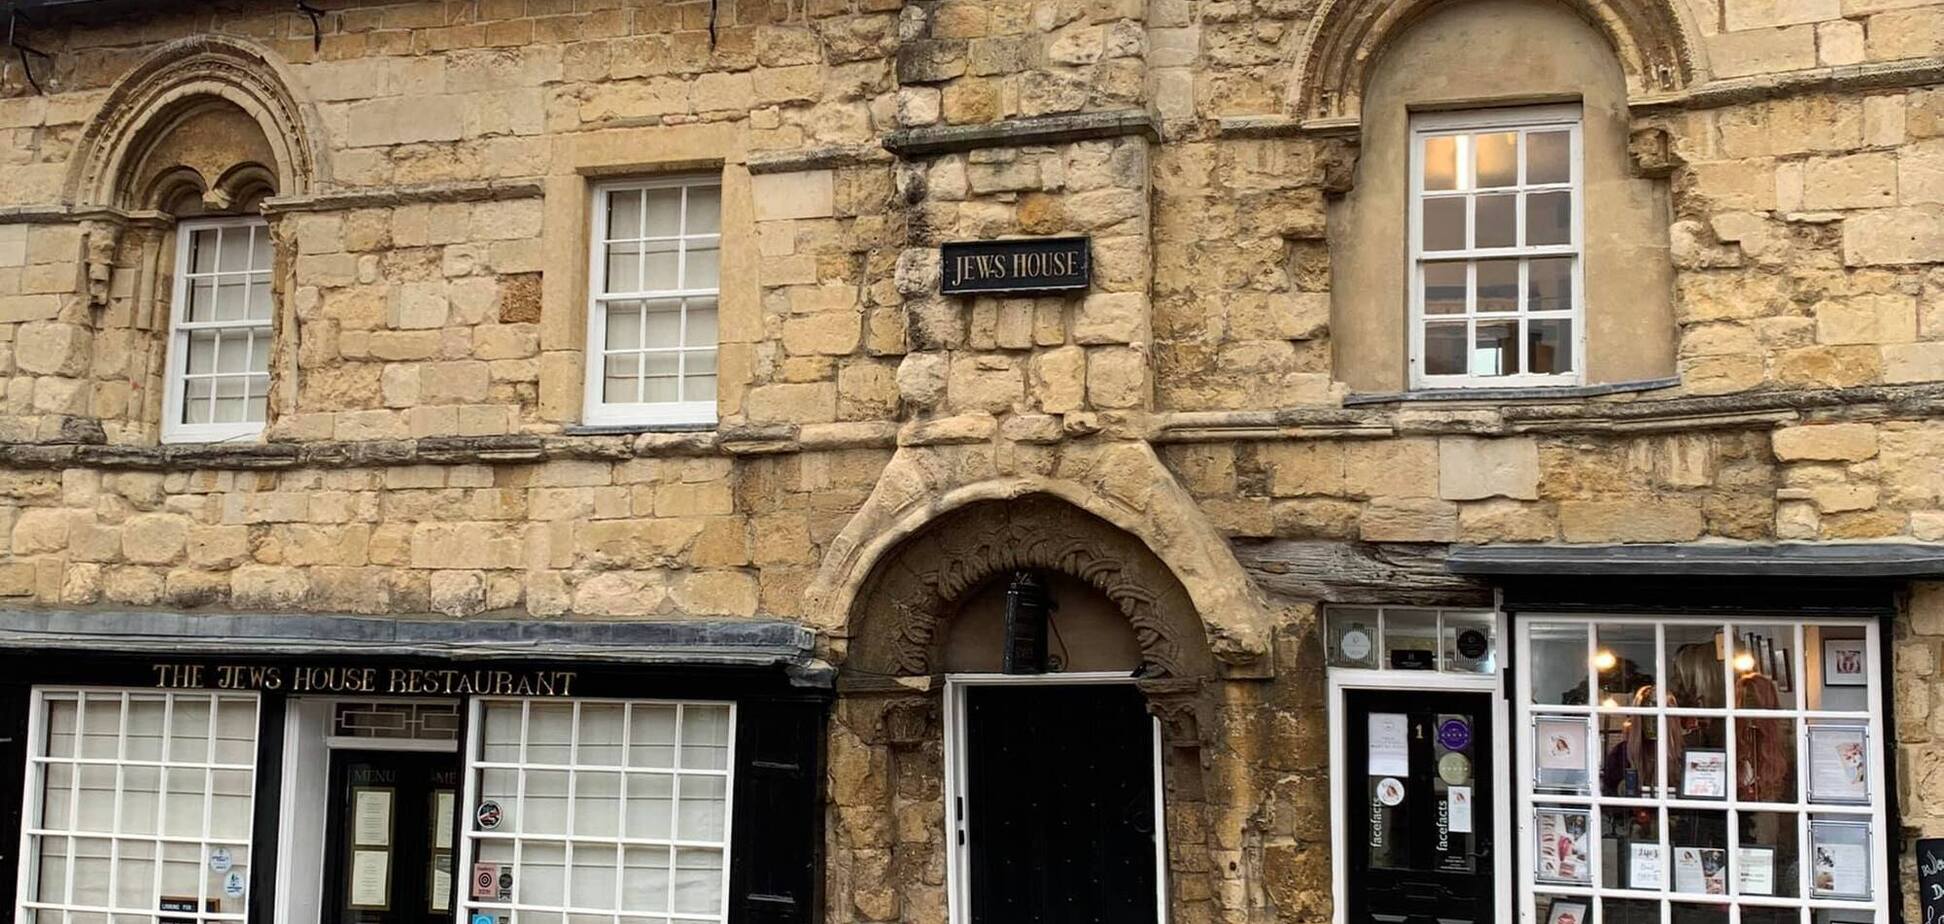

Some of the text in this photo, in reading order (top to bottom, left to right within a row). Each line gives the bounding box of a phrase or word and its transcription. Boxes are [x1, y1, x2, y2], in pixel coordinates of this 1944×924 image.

[1012, 251, 1079, 278] HOUSE
[153, 664, 577, 696] THE JEWS HOUSE RESTAURANT
[1415, 724, 1424, 739] 1
[353, 769, 396, 782] MENU
[1370, 797, 1382, 848] facefacts
[1436, 800, 1448, 851] facefacts
